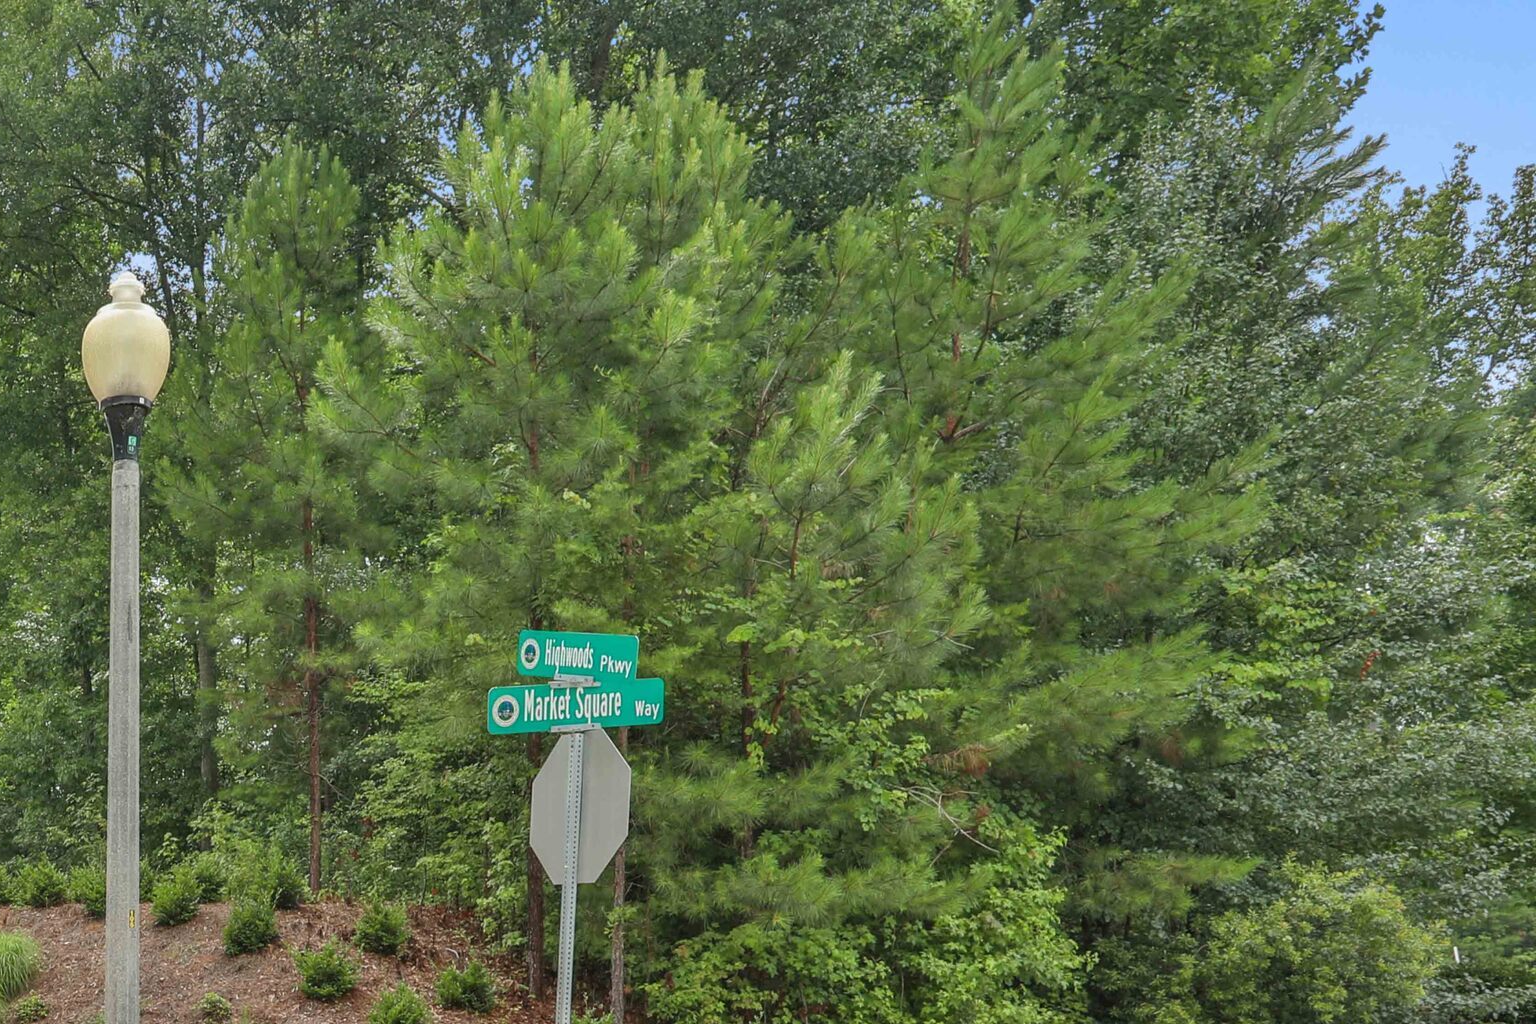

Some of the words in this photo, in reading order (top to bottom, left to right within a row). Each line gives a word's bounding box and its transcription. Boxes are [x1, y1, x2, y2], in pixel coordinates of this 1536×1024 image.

[544, 638, 594, 674] Highwoods
[599, 655, 633, 679] Pkwy
[523, 688, 571, 722] Market
[575, 687, 622, 724] Square
[635, 700, 660, 720] Way
